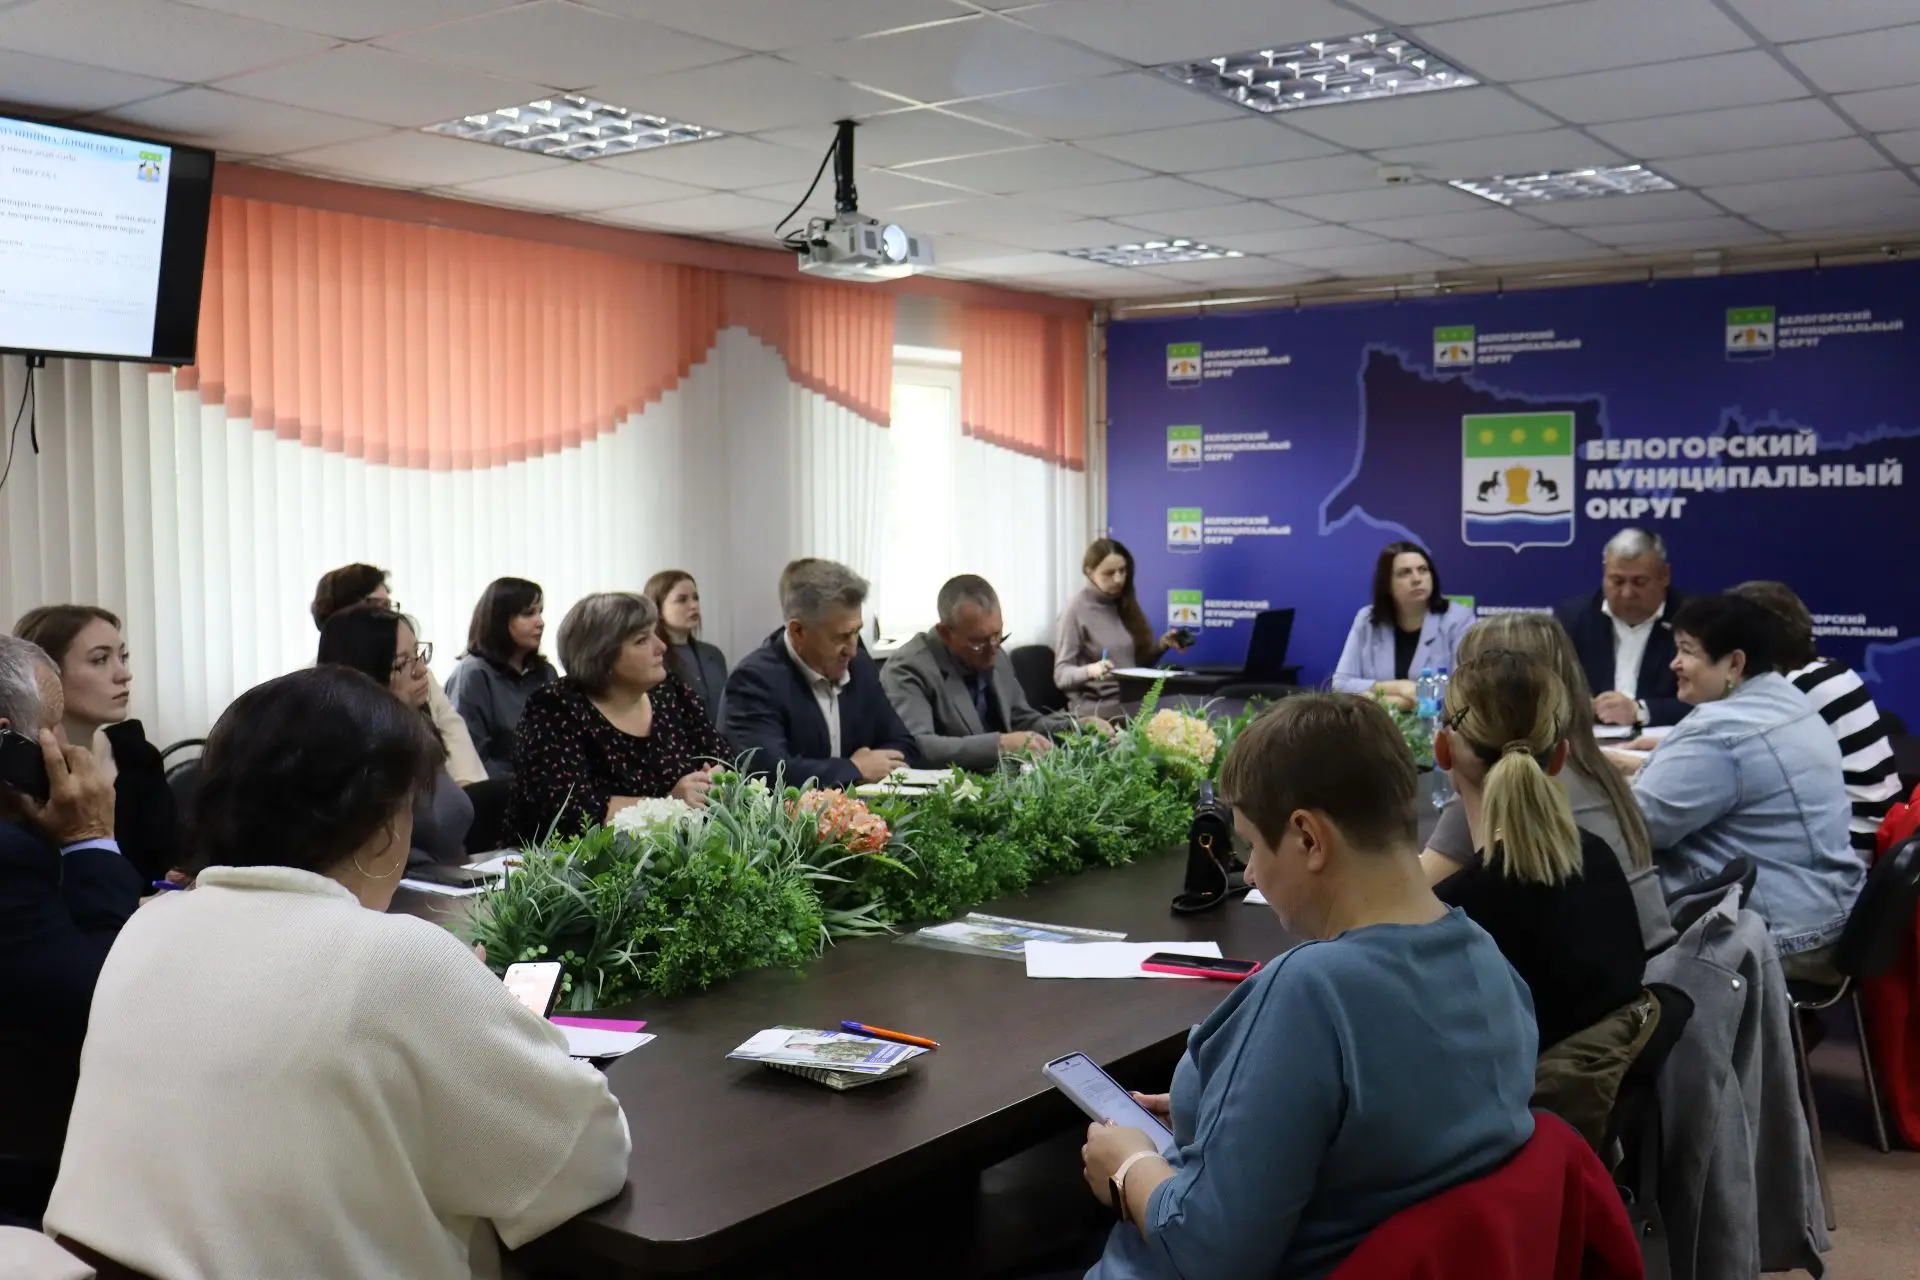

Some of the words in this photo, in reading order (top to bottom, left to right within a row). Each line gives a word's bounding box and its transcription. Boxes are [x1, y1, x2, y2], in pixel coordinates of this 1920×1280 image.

[1779, 309, 1871, 325] БЕЛОГОРСКИЙ
[1779, 319, 1903, 336] МУНИЦИПАЛЬНЫЙ
[1779, 336, 1819, 348] ОКРУГ
[1586, 428, 1817, 461] БЕЛОГОРСКИЙ
[1585, 458, 1903, 492] МУНИЦИПАЛЬНЫЙ
[1585, 498, 1688, 519] ОКРУГ
[1204, 609, 1257, 619] МУНИЦИПА
